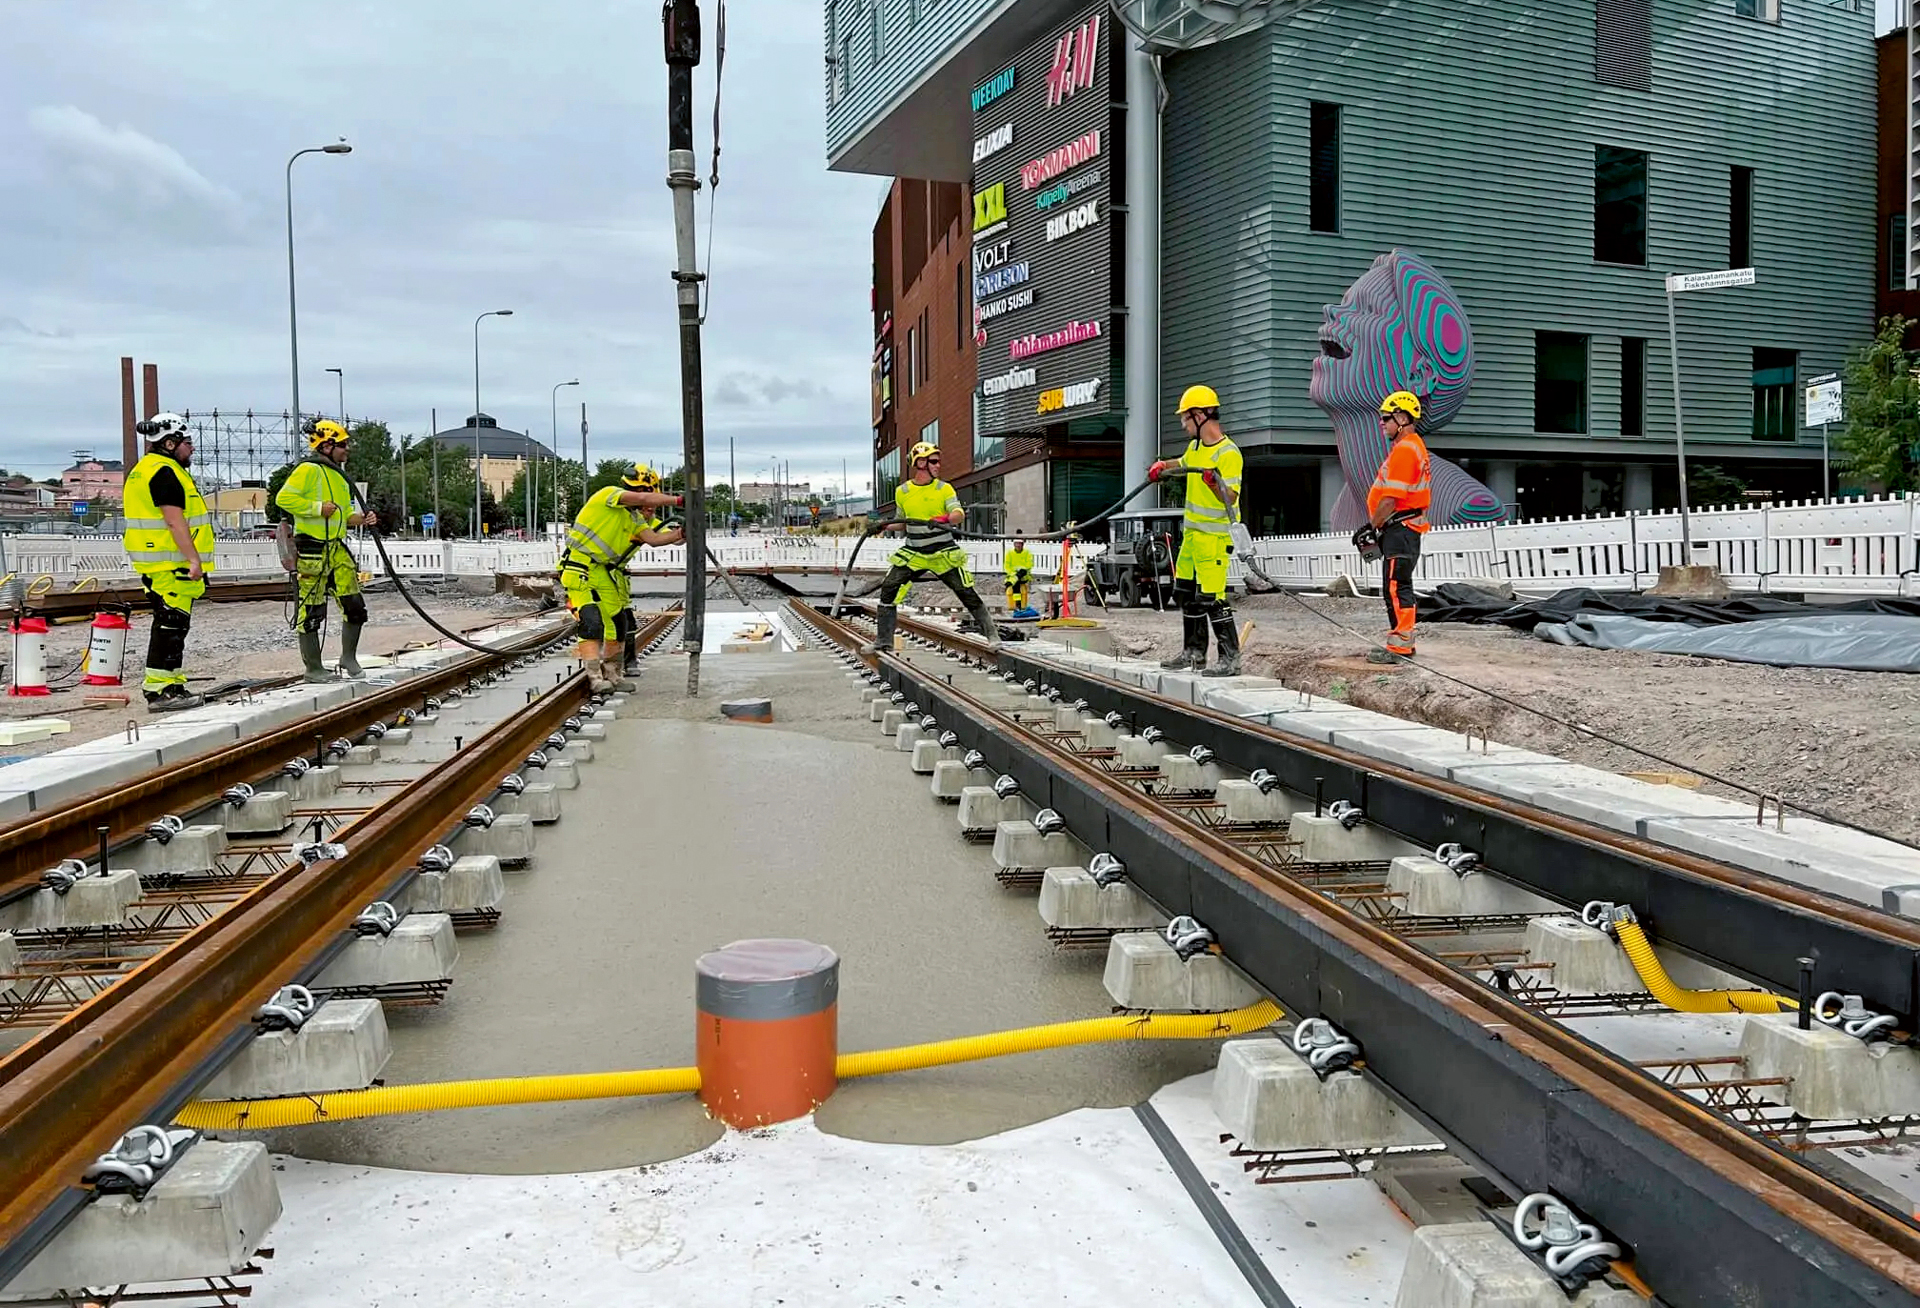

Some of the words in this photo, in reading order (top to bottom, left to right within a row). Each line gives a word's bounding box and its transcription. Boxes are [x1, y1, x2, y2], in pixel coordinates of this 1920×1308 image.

[1046, 15, 1100, 108] H&M
[971, 67, 1016, 112] WEEKDAY
[972, 122, 1013, 163] ELIXIA
[1020, 130, 1100, 190] TOKMANNI
[973, 181, 1007, 231] XXL
[975, 240, 1011, 272] VOLT
[975, 261, 1029, 297] CARLSON
[1684, 271, 1753, 283] Kalasatamankatu
[1684, 277, 1753, 290] Fiskehamnsgatan
[980, 300, 1006, 321] HANKO
[1008, 289, 1033, 311] SUSHI
[983, 365, 1036, 396] emotion
